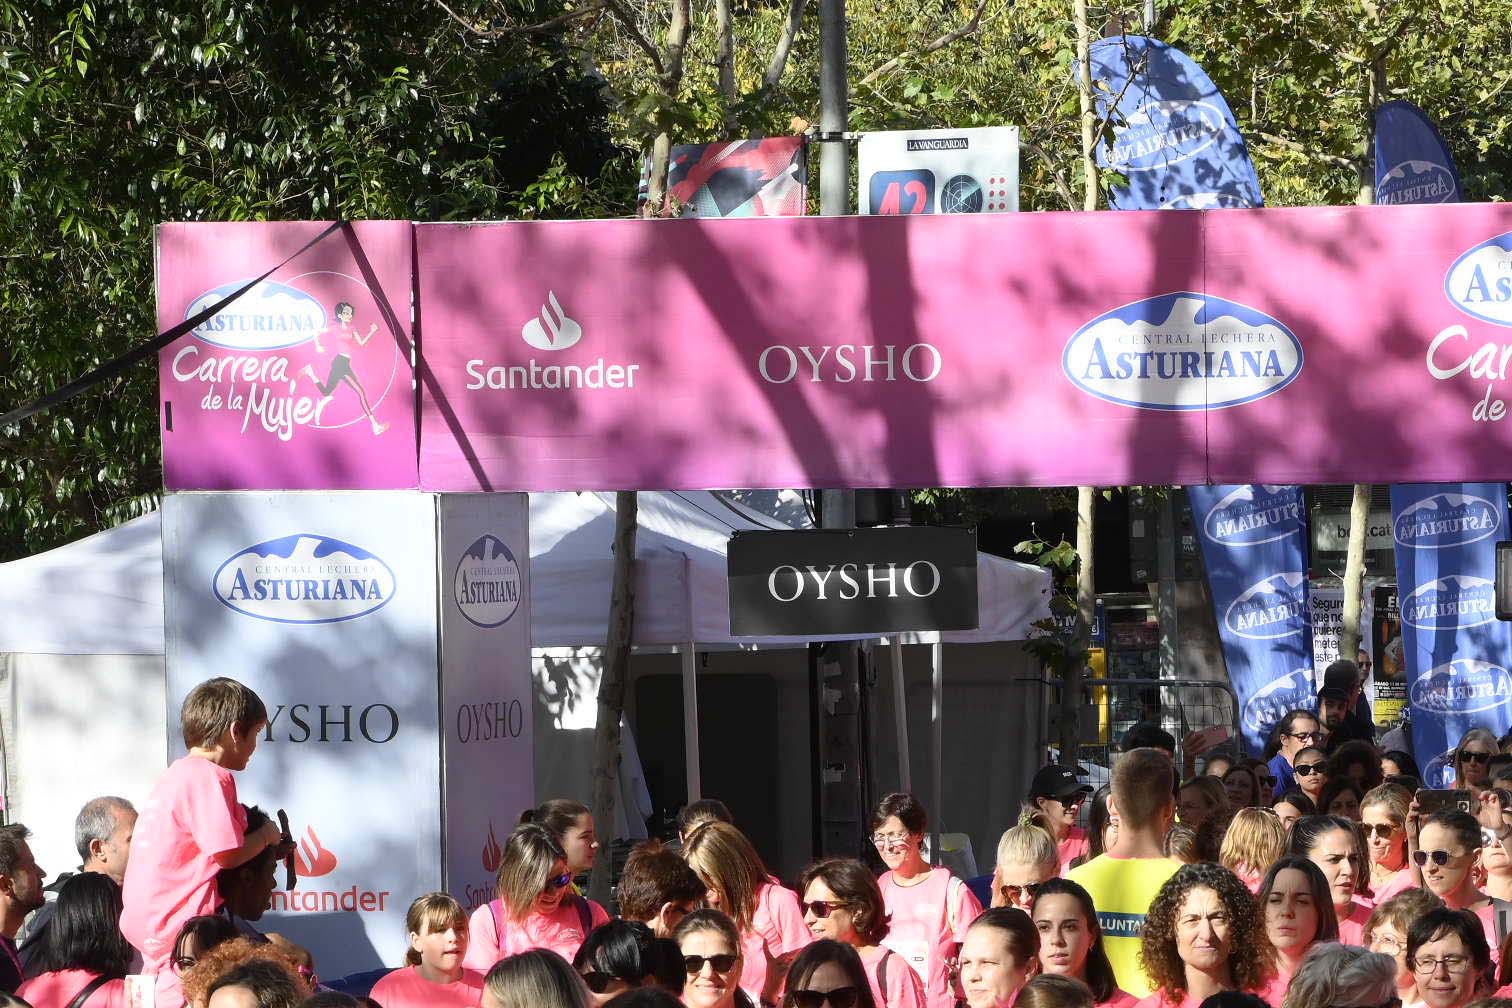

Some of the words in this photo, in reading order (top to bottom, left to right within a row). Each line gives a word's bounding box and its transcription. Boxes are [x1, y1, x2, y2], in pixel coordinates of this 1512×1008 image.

[1118, 333, 1193, 345] CENTRAL
[1201, 332, 1277, 345] LECHERA
[171, 344, 289, 383] Carrera
[465, 358, 640, 391] Santander
[757, 343, 943, 384] OYSHO
[1081, 337, 1285, 380] ASTURIANA
[200, 383, 222, 410] de
[227, 384, 244, 411] la
[240, 379, 334, 441] Mujer
[1472, 382, 1507, 422] de
[228, 567, 384, 601] ASTURIANA
[459, 568, 518, 605] ASTURIANA
[768, 560, 941, 602] OYSHO
[1314, 625, 1344, 639] quiere
[263, 703, 400, 744] YSHO
[456, 699, 523, 744] OYSHO
[270, 885, 391, 912] ntander
